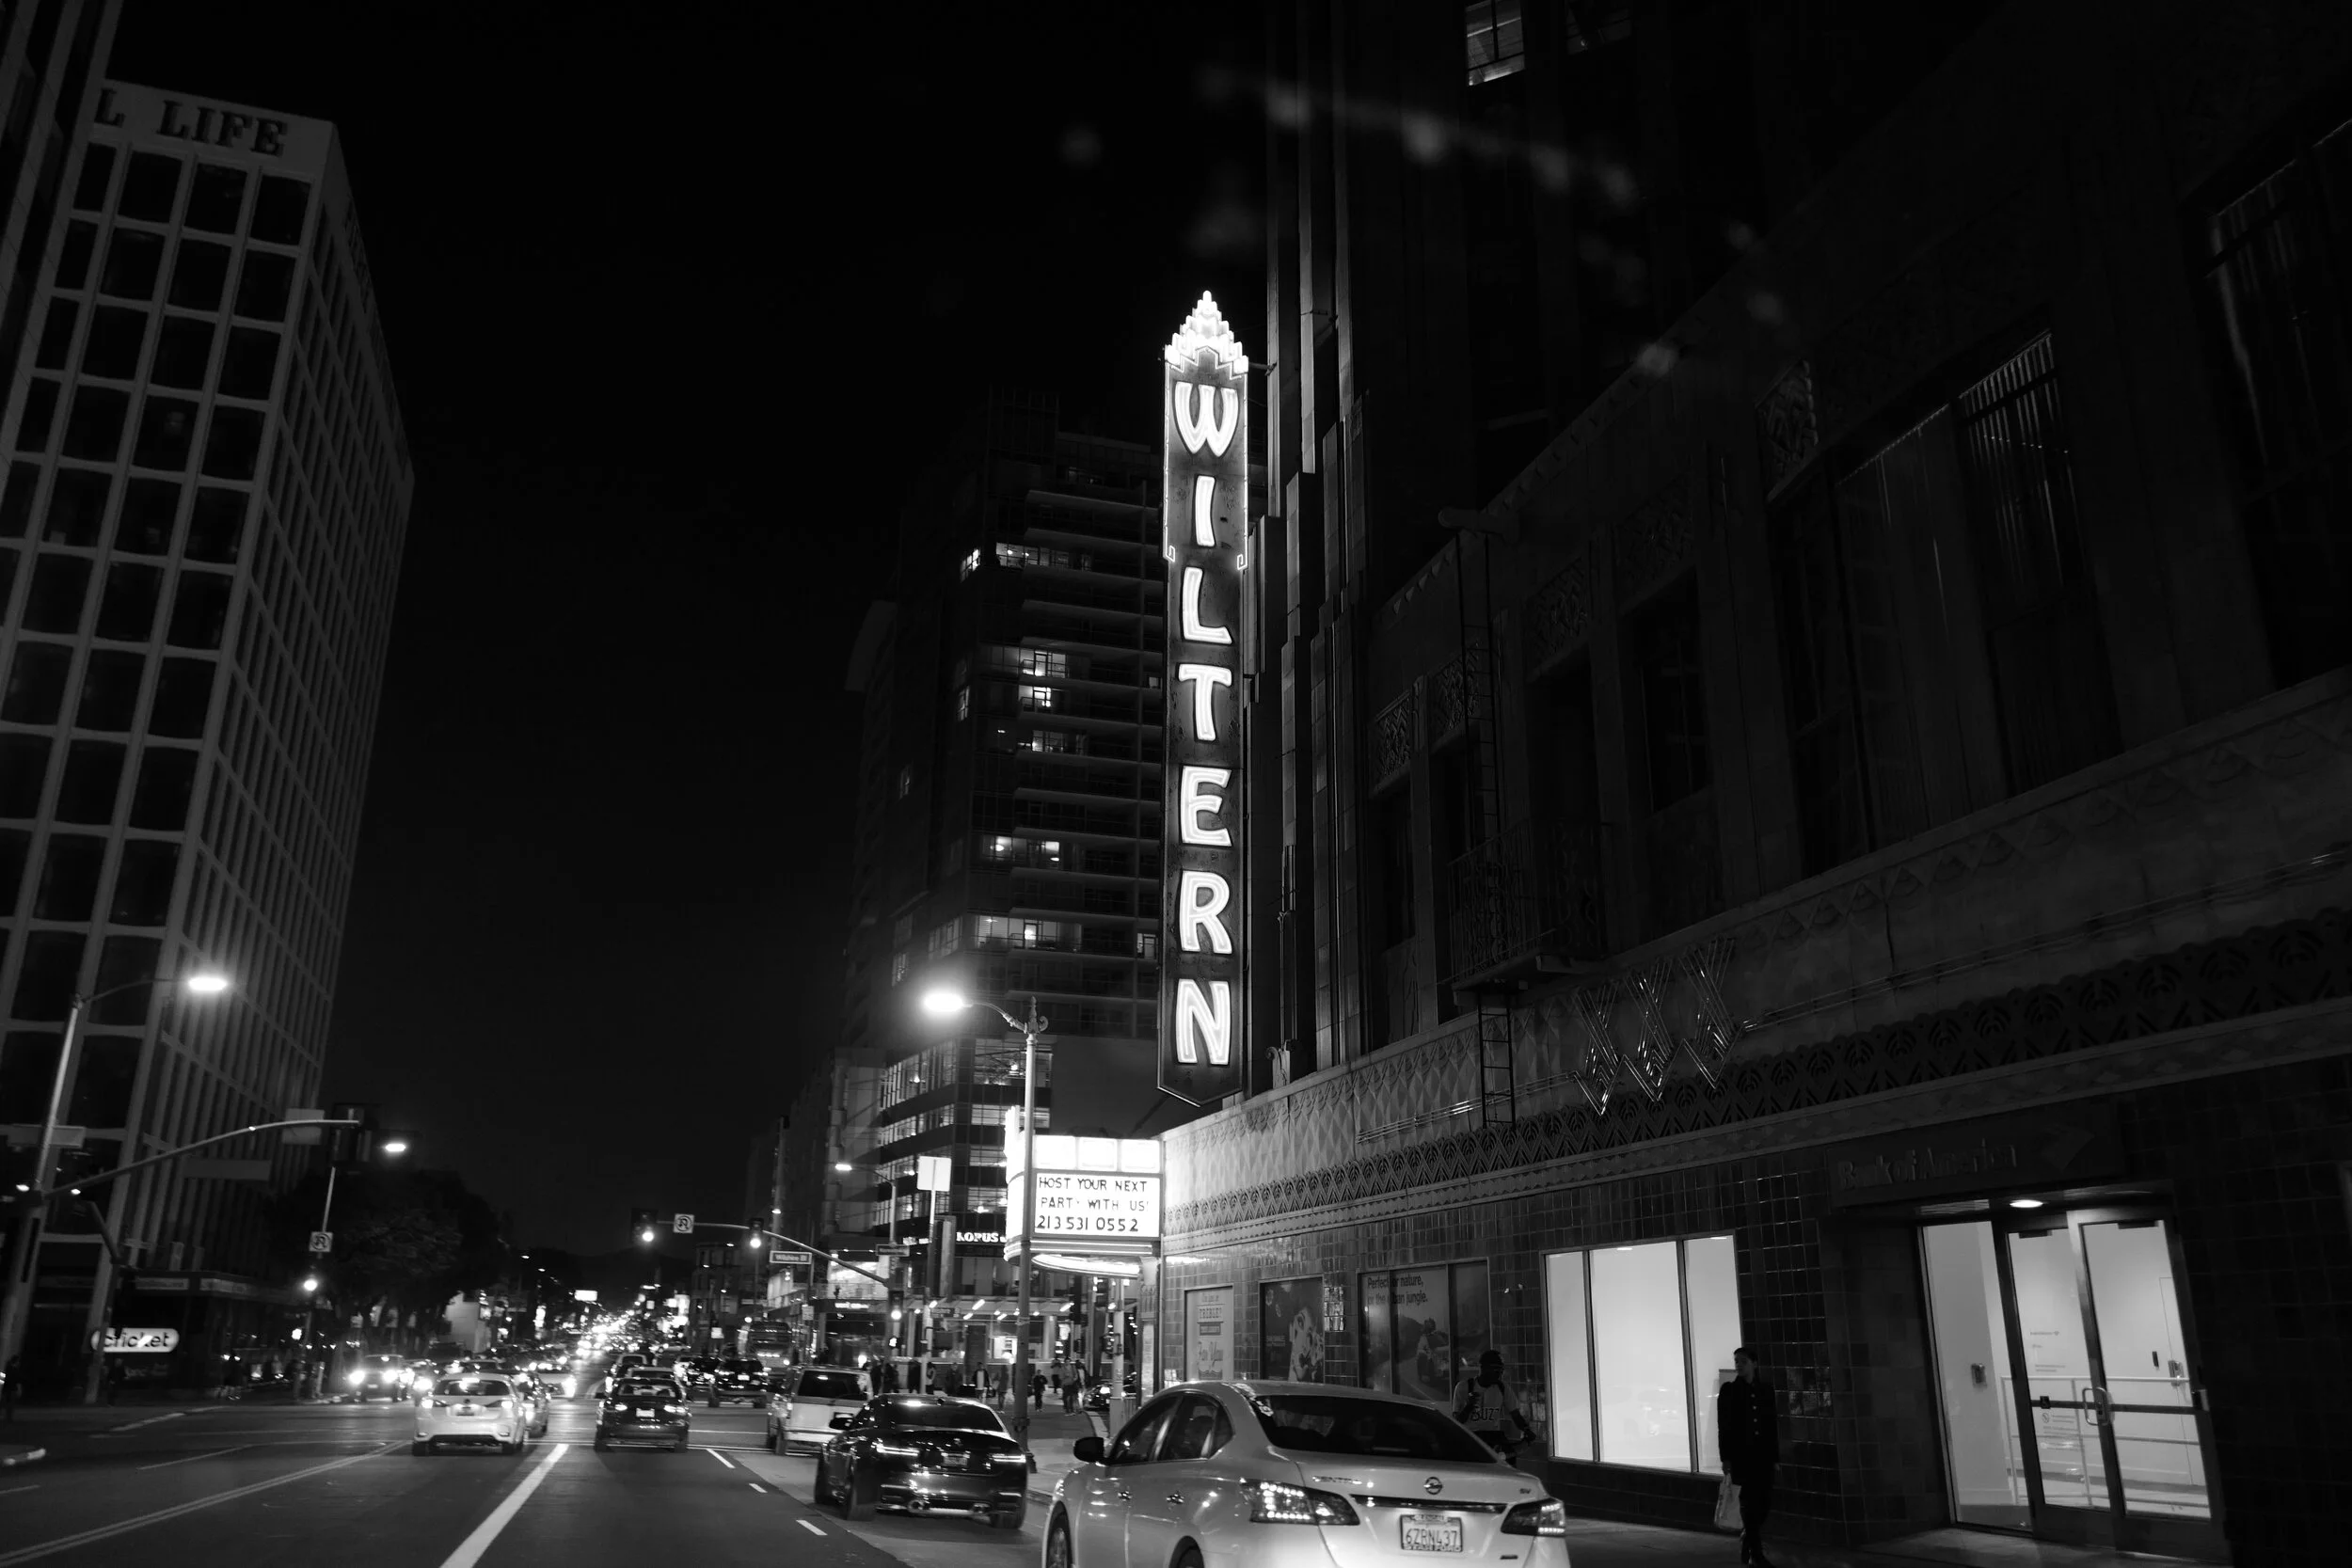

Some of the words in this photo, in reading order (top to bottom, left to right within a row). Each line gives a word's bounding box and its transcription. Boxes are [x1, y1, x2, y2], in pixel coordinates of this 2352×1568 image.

[156, 100, 287, 157] LIFE
[1175, 381, 1239, 1065] WILTERN
[1039, 1177, 1071, 1189] HOST
[1077, 1178, 1107, 1191] YOUR
[1115, 1180, 1148, 1193] NEXT
[1088, 1198, 1120, 1211] WITH
[1036, 1214, 1061, 1229] 213
[1066, 1216, 1089, 1230] 531
[1096, 1216, 1138, 1232] 0552
